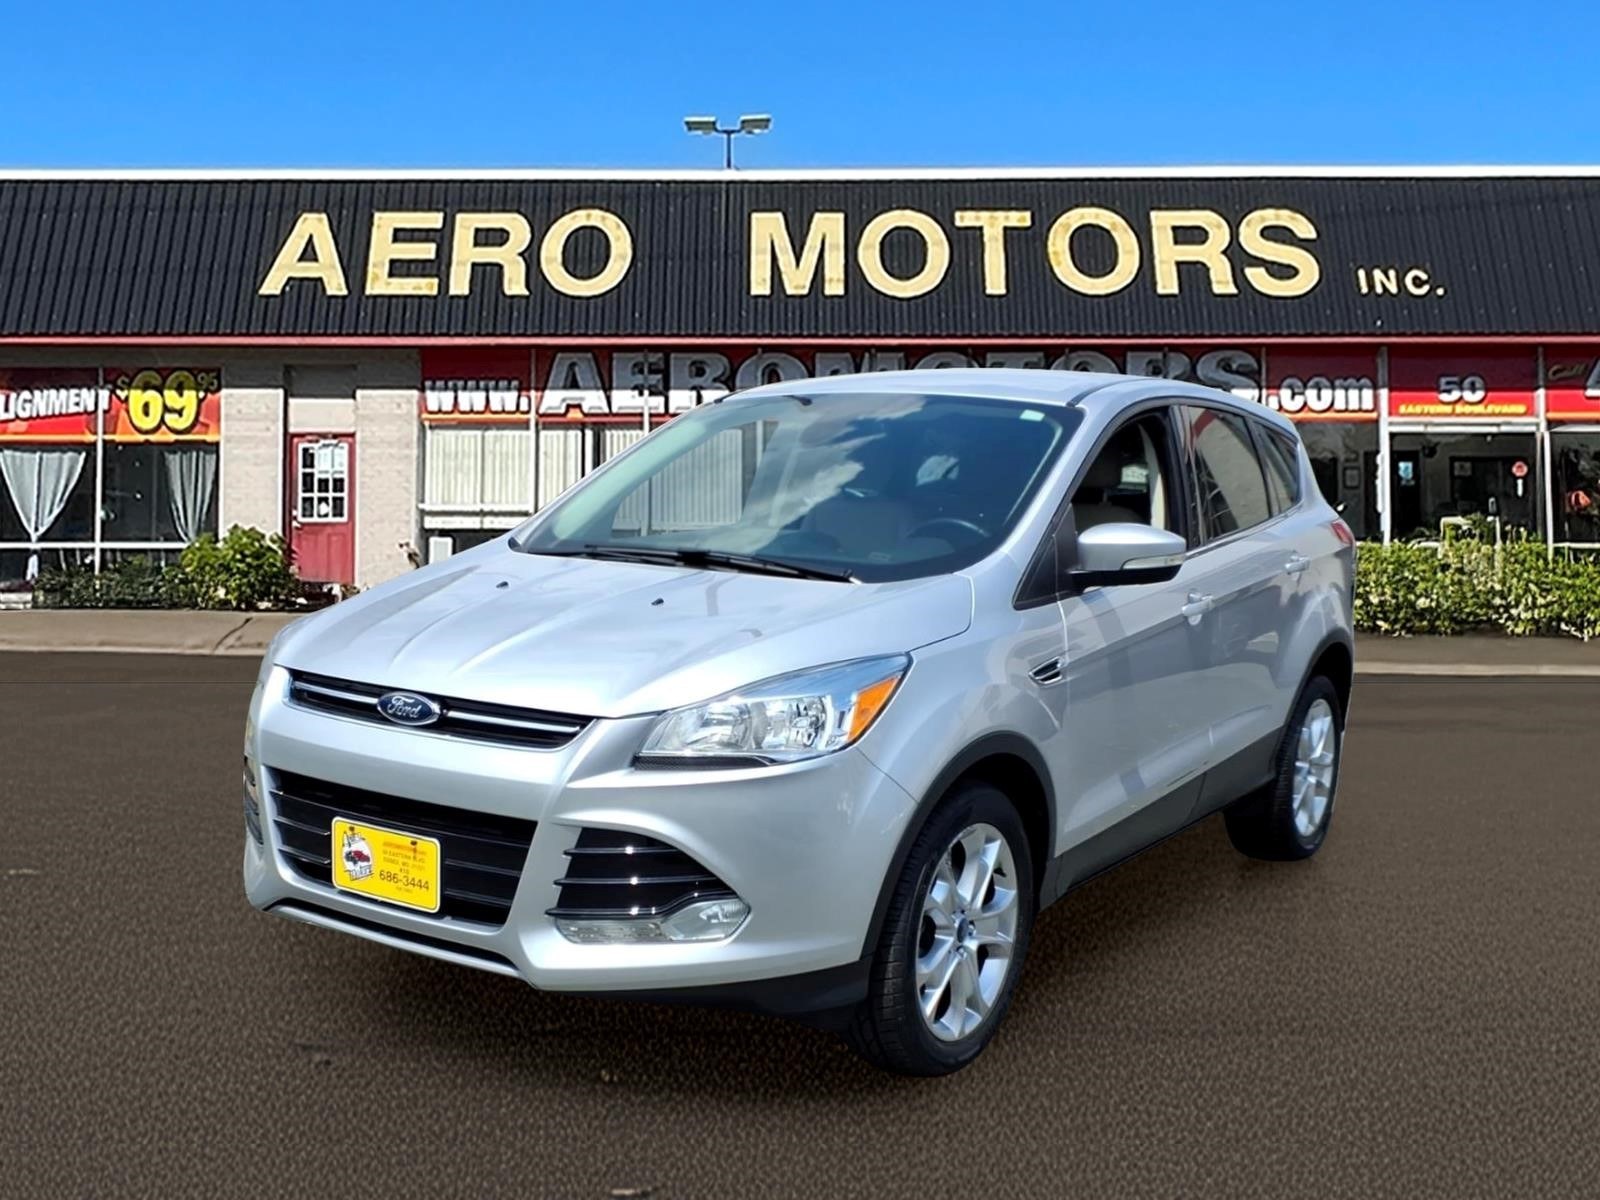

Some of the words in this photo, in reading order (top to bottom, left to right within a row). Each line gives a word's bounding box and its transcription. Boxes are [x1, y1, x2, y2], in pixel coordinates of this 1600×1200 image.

[257, 208, 633, 297] AERO
[749, 207, 1321, 298] MOTORS
[1357, 268, 1445, 296] INC.
[1438, 376, 1486, 403] 50
[387, 695, 422, 718] Ford
[379, 870, 430, 891] 686-3444
